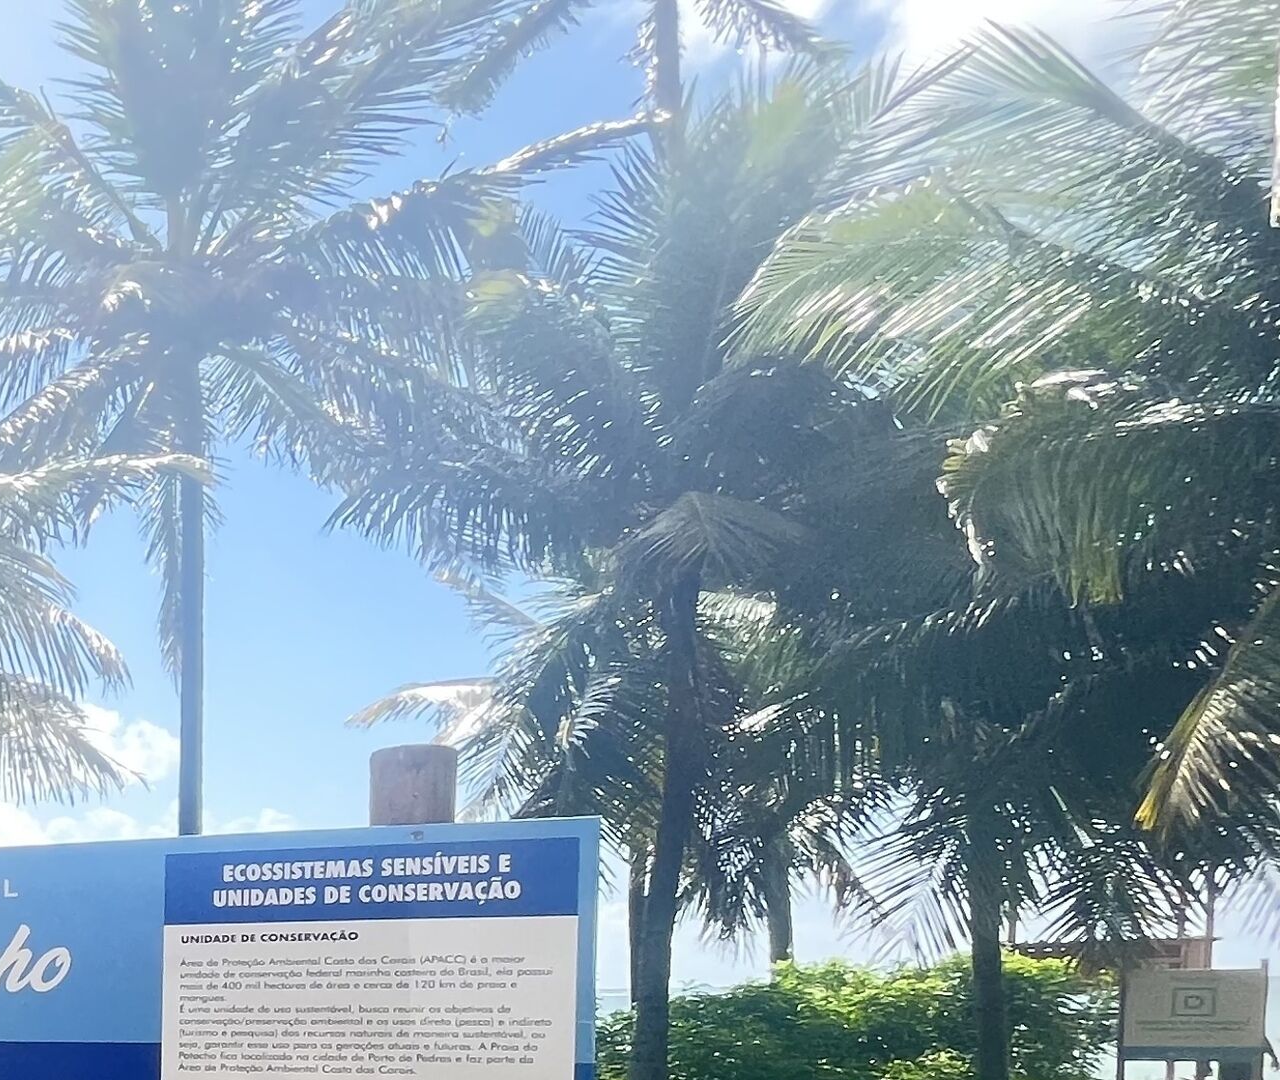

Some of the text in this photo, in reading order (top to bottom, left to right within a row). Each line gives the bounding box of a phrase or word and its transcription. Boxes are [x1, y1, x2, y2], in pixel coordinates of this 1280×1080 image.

[223, 852, 510, 882] ECOSSISTEMAS SENSÍVEIS E
[213, 877, 520, 907] UNIDADES DE CONSERVAÇÃO
[181, 929, 358, 943] UNIDADE DE CONSERVAÇÃO
[221, 958, 266, 968] Proteção
[419, 954, 467, 967] (APACC)
[238, 968, 304, 980] conservação
[305, 967, 342, 977] federal
[221, 981, 242, 990] 400
[244, 980, 260, 989] mil
[415, 979, 435, 988] 120
[368, 1052, 396, 1062] Porto
[220, 1062, 264, 1074] Proteção
[265, 1063, 318, 1073] Ambiental
